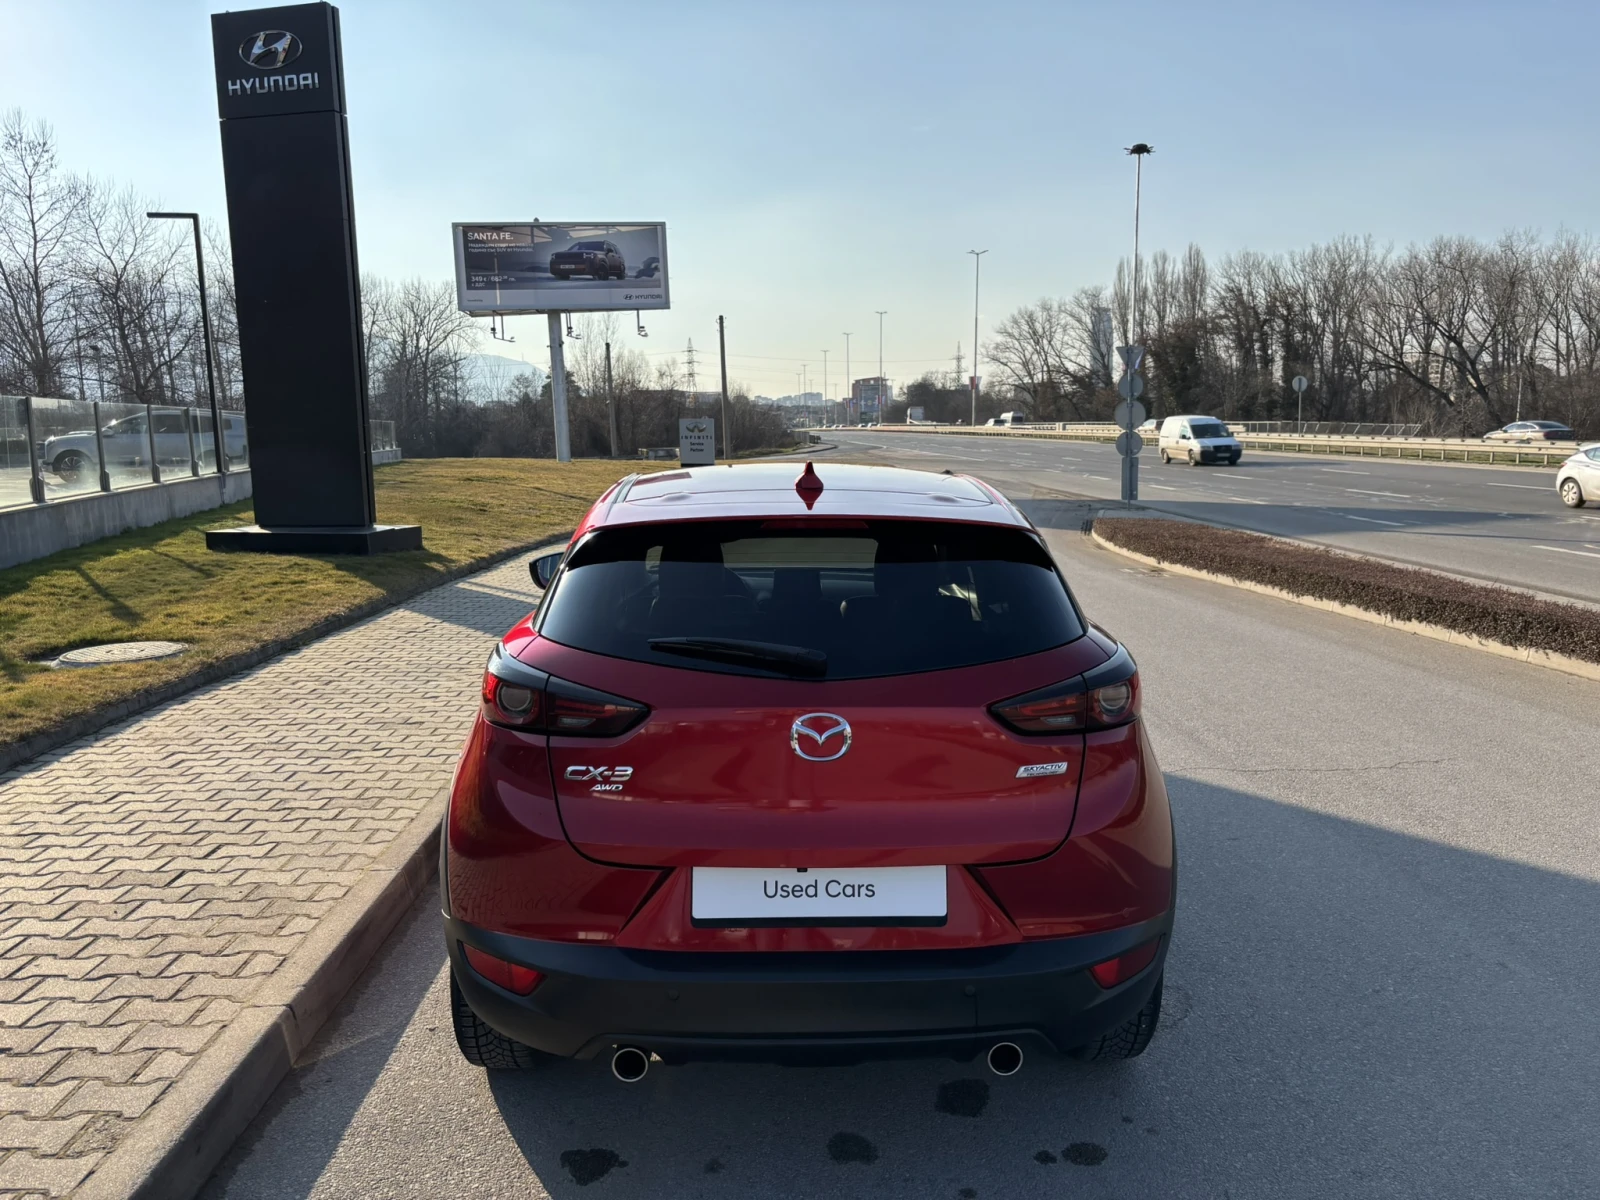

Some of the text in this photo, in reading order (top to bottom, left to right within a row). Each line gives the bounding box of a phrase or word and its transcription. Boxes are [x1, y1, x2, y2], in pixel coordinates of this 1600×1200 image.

[227, 72, 319, 96] HYUNDAI
[467, 232, 514, 240] SANTA FE.
[564, 765, 634, 781] CX-3
[1023, 763, 1063, 772] SKYACTIV
[763, 879, 876, 898] Used Cars
